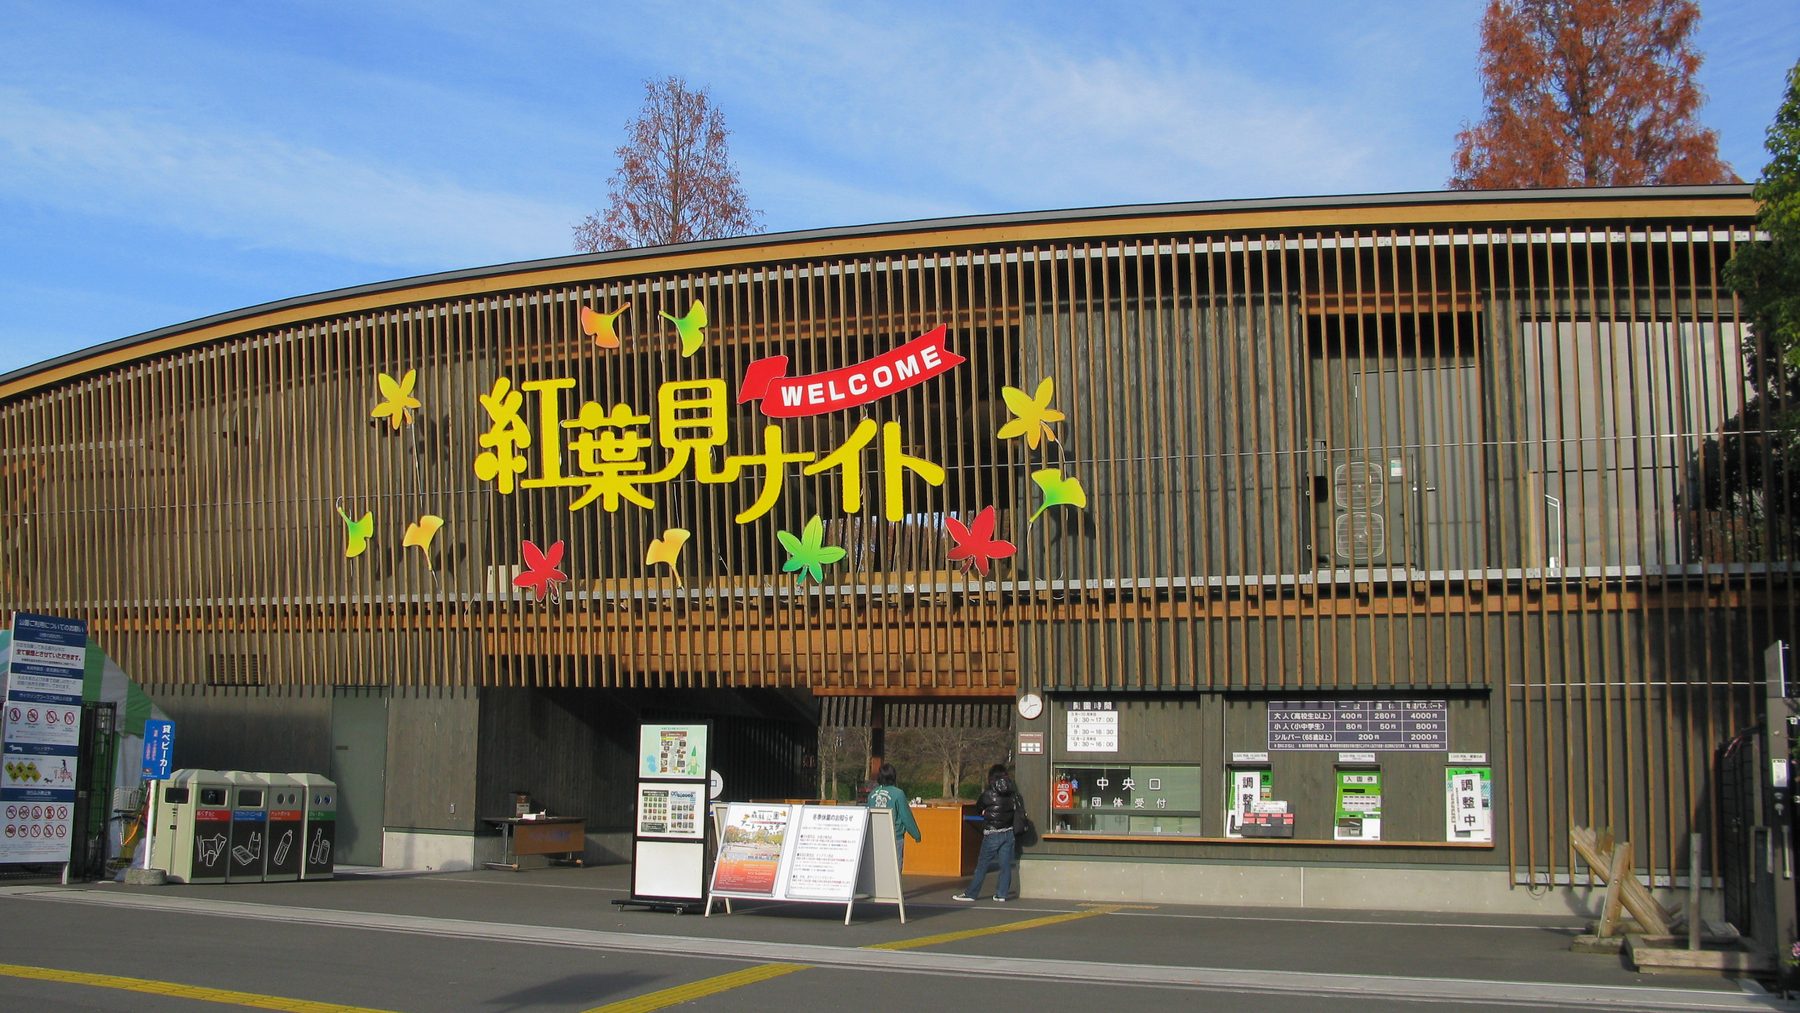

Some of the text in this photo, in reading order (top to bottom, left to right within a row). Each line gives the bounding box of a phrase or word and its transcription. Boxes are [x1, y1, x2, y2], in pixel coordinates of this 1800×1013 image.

[780, 345, 942, 408] WELCOME
[474, 376, 946, 524] 紅葉見ナイト
[1091, 797, 1167, 809] 団体受付
[1096, 777, 1161, 790] 中央口
[1461, 779, 1477, 827] 調整中
